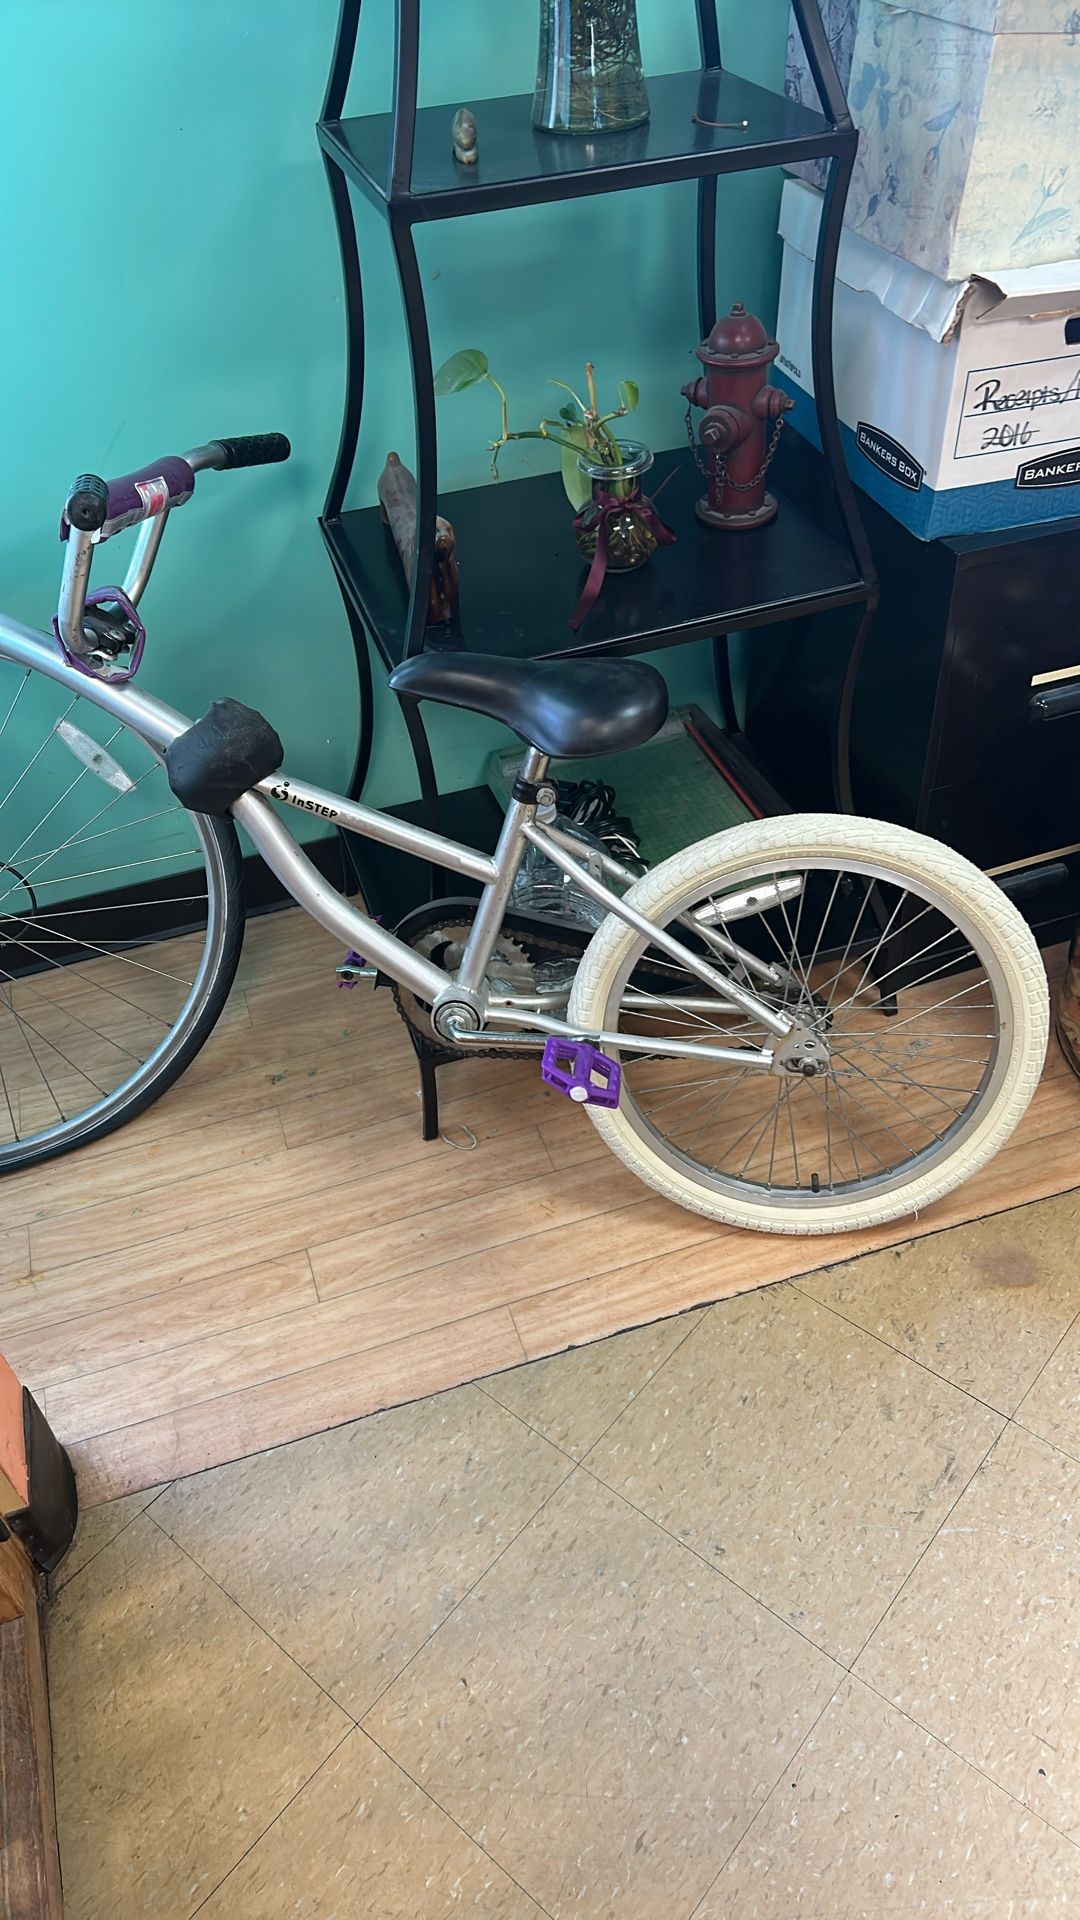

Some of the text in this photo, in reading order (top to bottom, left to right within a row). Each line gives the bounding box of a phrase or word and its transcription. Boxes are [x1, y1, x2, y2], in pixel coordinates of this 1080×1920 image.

[980, 421, 1034, 450] 2016
[860, 431, 917, 482] BANKERS BOX
[292, 795, 338, 818] InSTEP
